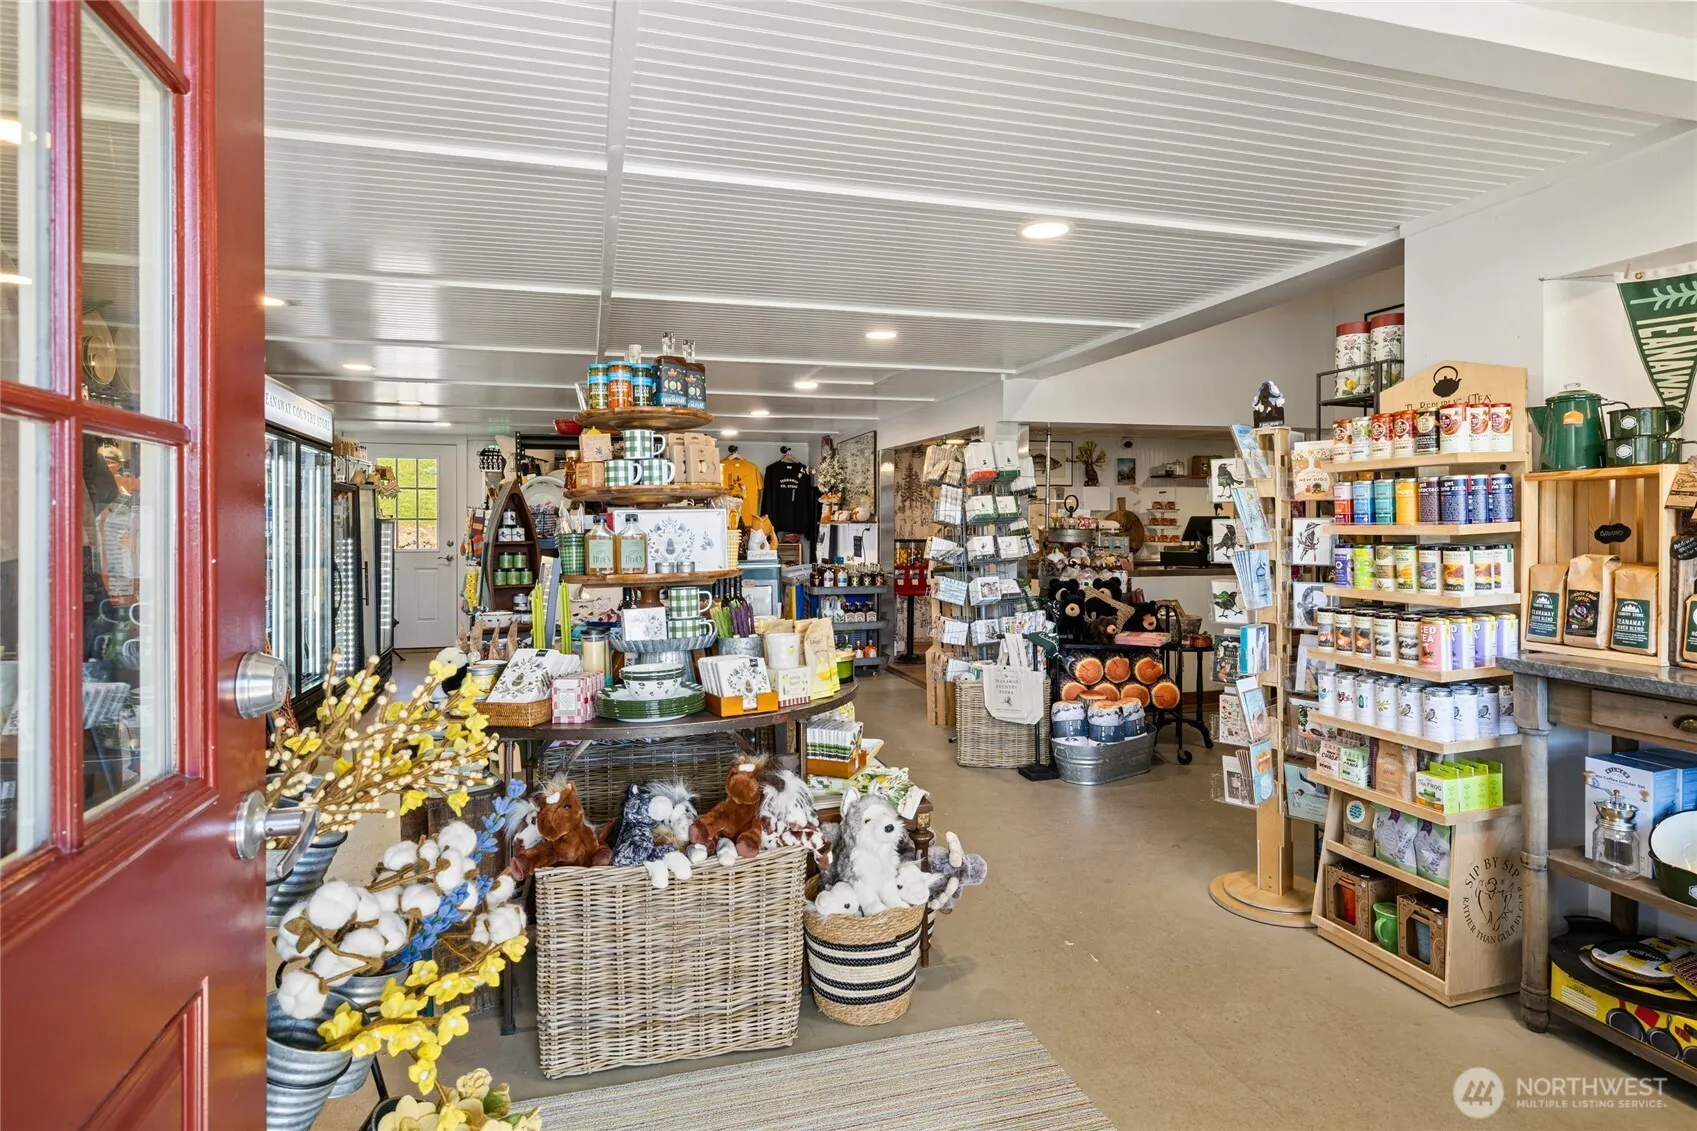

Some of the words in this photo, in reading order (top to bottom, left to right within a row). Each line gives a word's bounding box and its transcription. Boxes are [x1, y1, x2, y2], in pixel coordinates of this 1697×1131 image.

[265, 392, 291, 415] EANAWAY
[292, 405, 316, 425] COUNTRY
[316, 416, 330, 431] STORE
[1426, 782, 1442, 792] FROG
[1603, 775, 1618, 783] Coffee
[1619, 779, 1636, 787] Grinder
[1464, 865, 1480, 889] SIP
[1484, 856, 1499, 870] BY
[1502, 859, 1520, 877] SIP
[1462, 896, 1477, 933] RATHER
[1476, 930, 1497, 944] THAN
[1497, 924, 1518, 943] GULP
